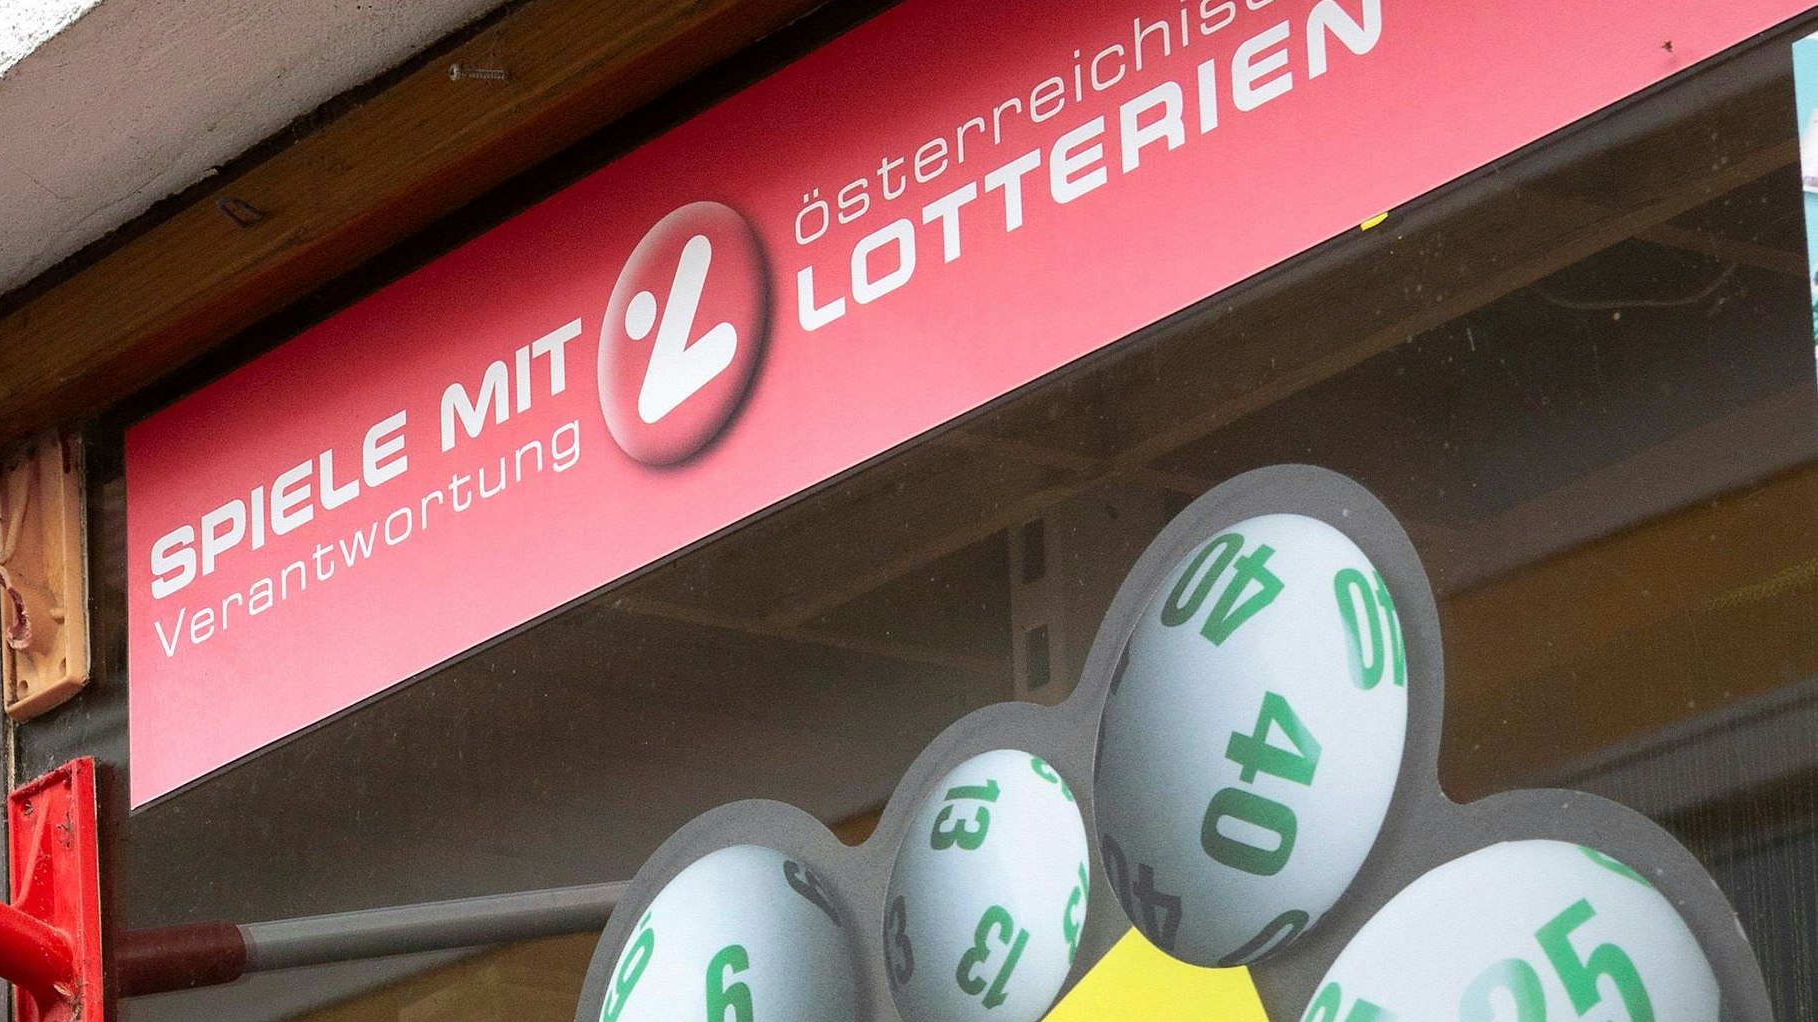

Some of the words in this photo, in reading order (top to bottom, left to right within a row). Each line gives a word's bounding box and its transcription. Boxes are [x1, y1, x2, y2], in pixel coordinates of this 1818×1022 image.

[794, 0, 1275, 246] österreichis
[796, 0, 1382, 332] LOTTERIEN
[149, 410, 409, 600] SPIELE
[440, 317, 582, 452] MIT
[154, 418, 582, 659] Verantwortung
[1160, 532, 1285, 648] 40
[930, 778, 1001, 851] 13
[1200, 690, 1323, 877] 40
[955, 905, 1030, 1010] 13
